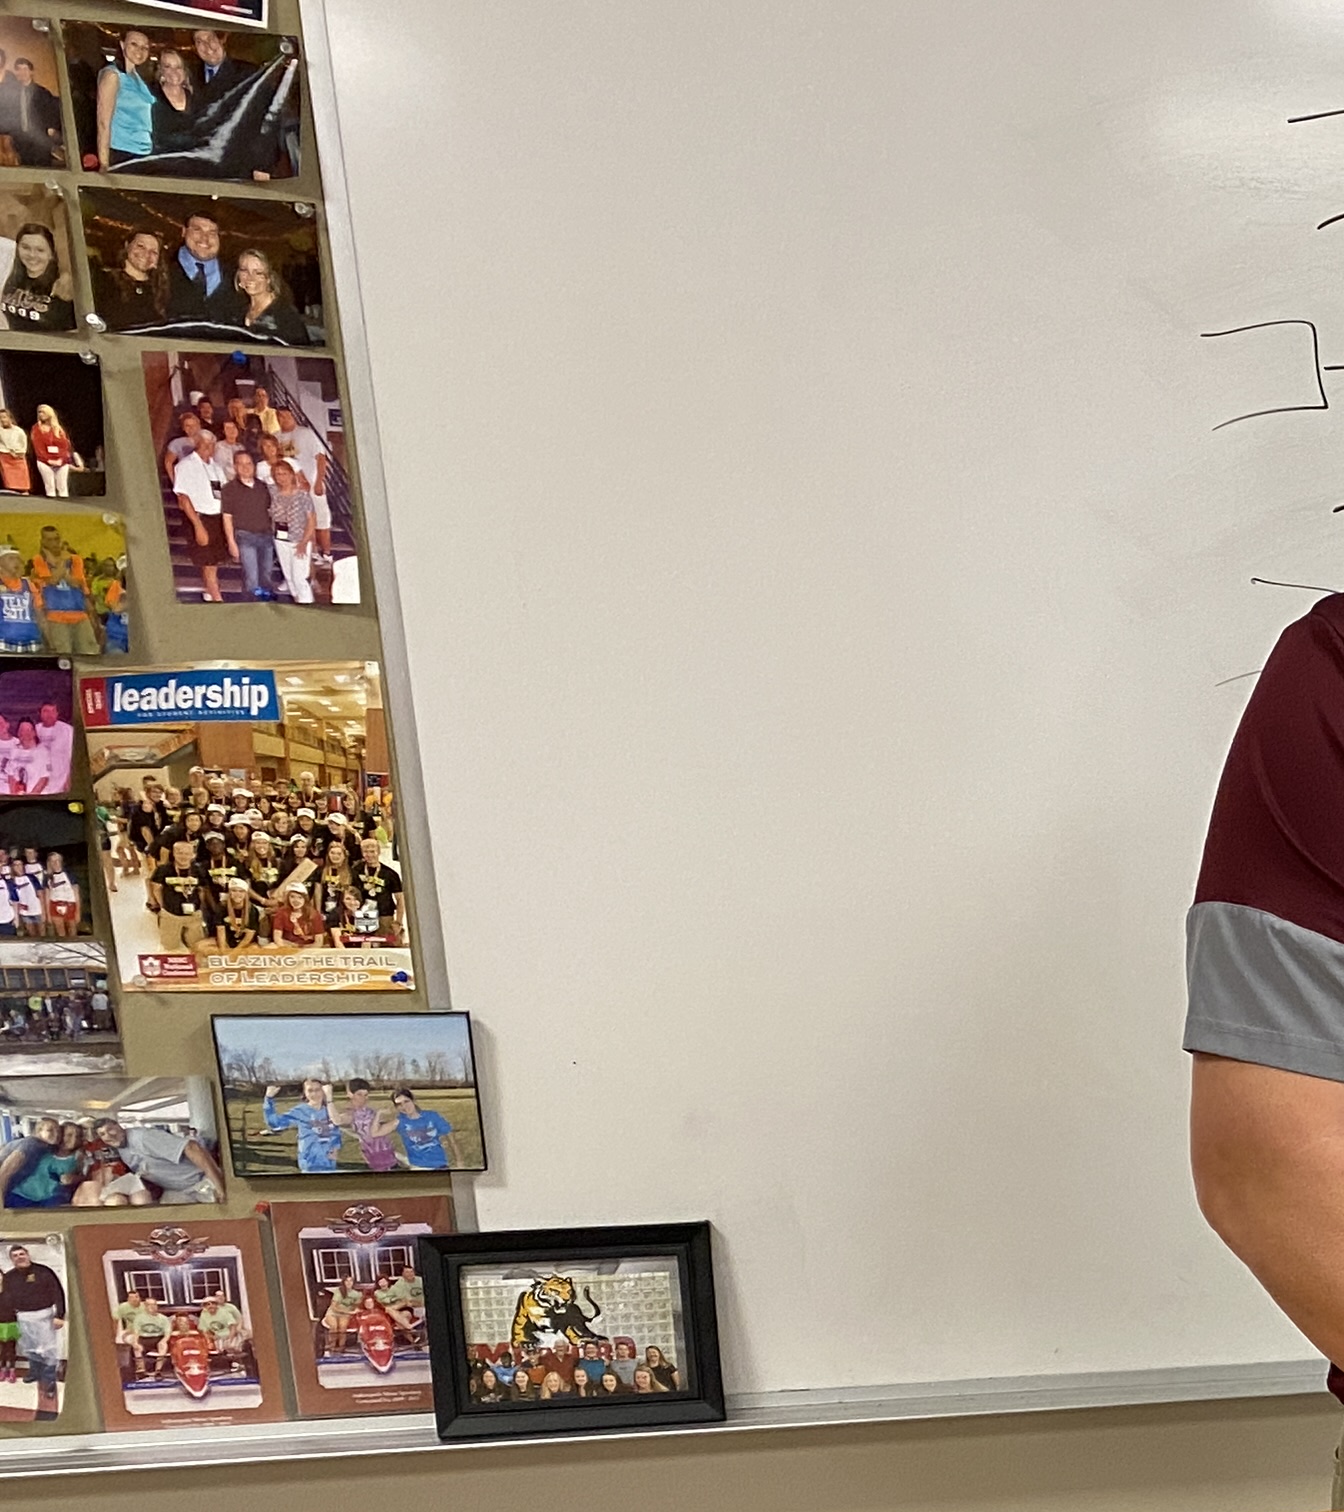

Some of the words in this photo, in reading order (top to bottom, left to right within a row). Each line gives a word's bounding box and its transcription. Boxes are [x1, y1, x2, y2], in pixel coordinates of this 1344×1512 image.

[113, 677, 269, 716] leadership
[209, 956, 296, 968] BLAZING
[303, 956, 334, 967] THE
[340, 956, 396, 967] TRAIL
[210, 973, 233, 984] OF
[242, 972, 370, 984] LEADERSHIP
